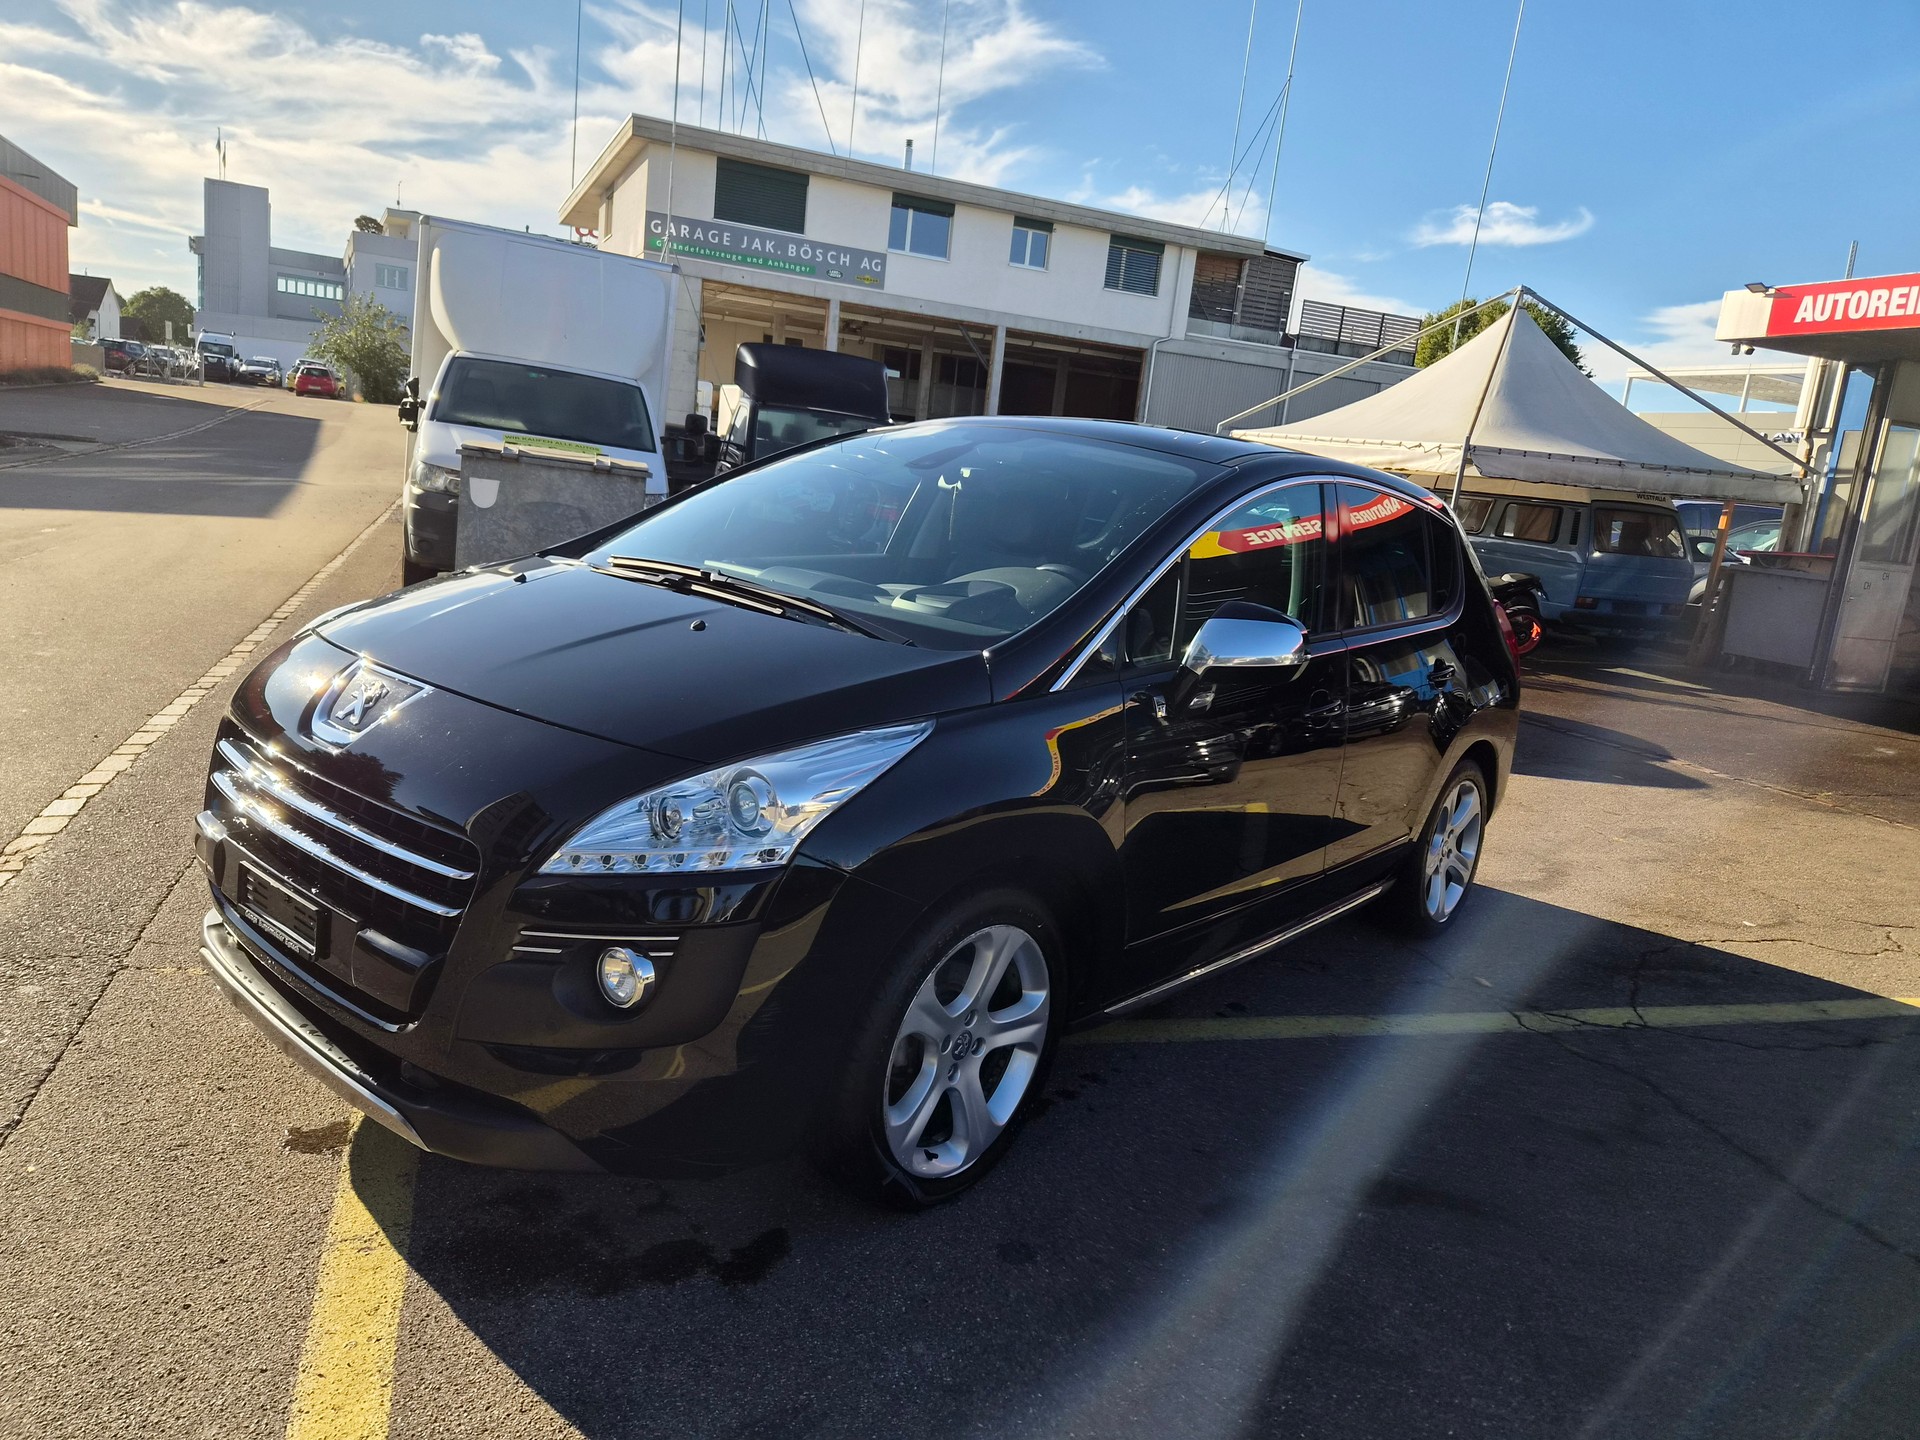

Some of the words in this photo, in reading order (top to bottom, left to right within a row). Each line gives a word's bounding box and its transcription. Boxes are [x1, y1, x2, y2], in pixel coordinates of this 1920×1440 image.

[650, 220, 731, 246] GARAGE
[740, 236, 781, 255] JAK.
[788, 243, 850, 267] BÖSCH
[860, 257, 882, 272] AG
[656, 240, 742, 261] Gländefahrzeuge
[747, 257, 763, 265] und
[768, 259, 810, 272] Anhänger
